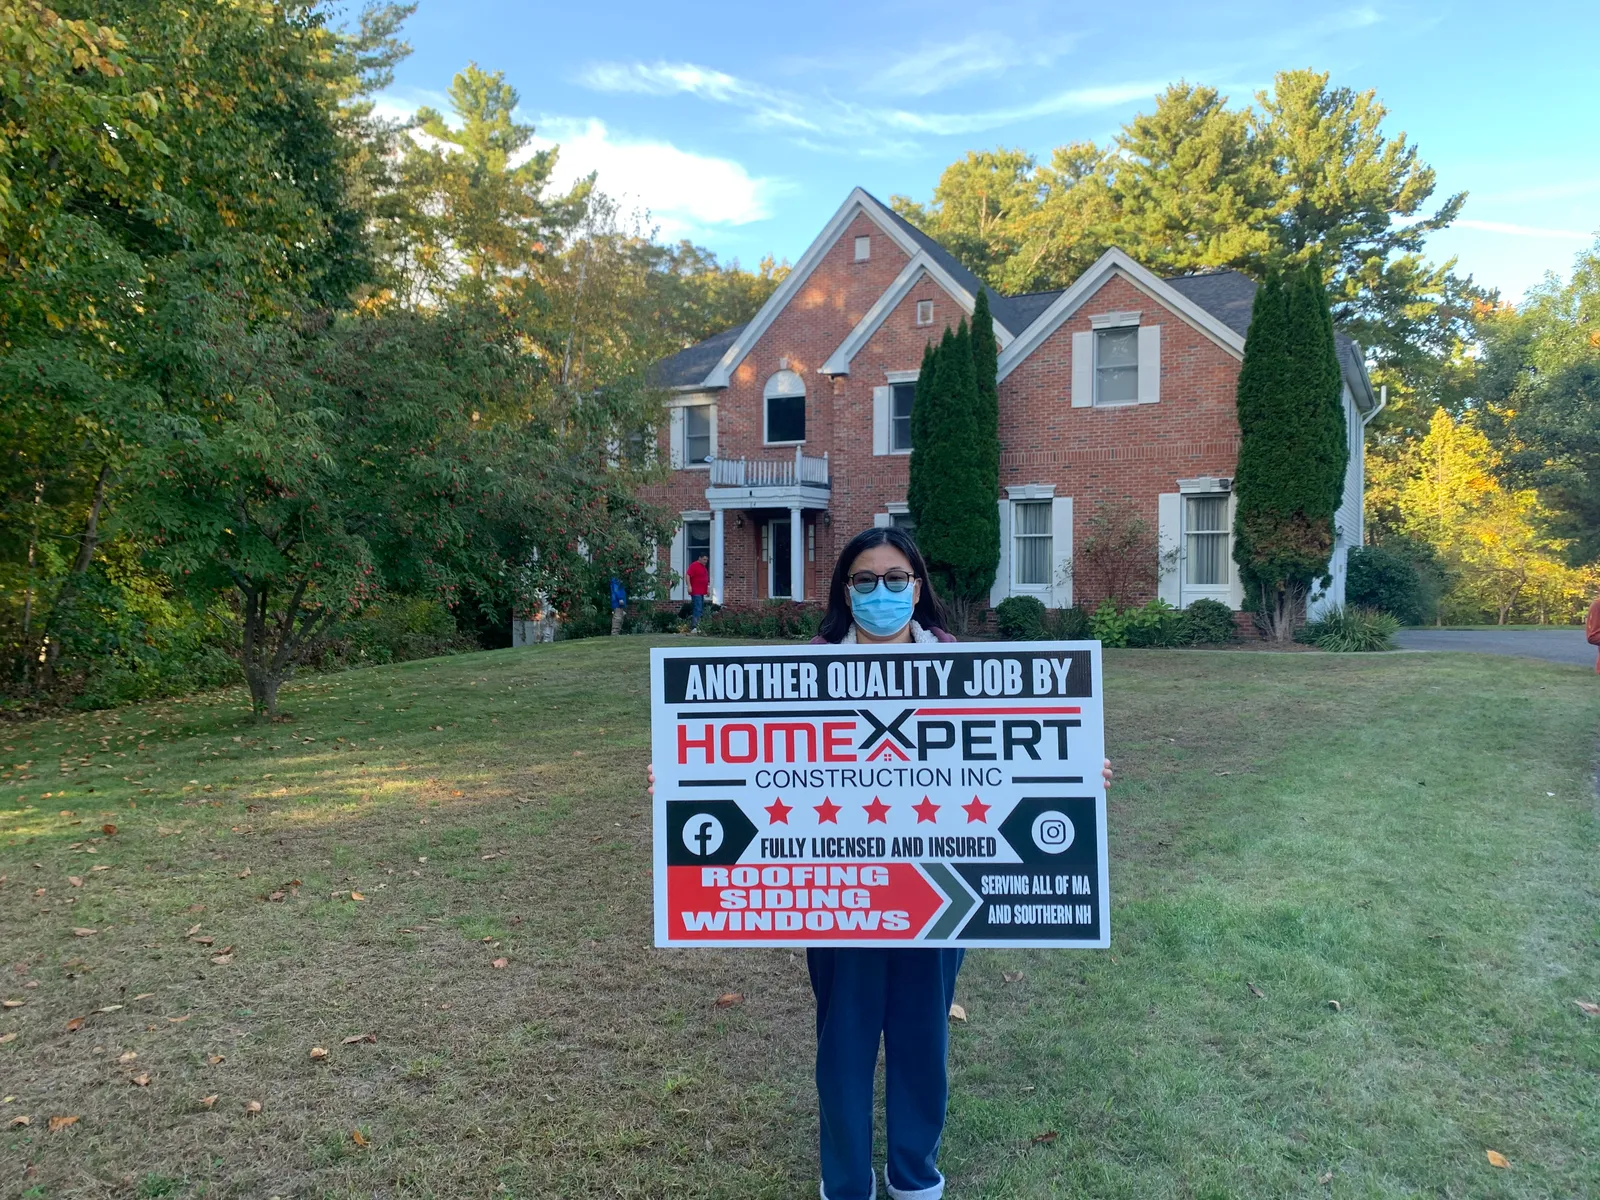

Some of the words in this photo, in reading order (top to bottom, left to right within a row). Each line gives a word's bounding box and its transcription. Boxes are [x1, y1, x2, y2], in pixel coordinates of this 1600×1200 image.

[685, 663, 818, 701] ANOTHER
[827, 660, 954, 698] QUALITY
[963, 658, 1024, 696] JOB
[1032, 657, 1073, 695] BY
[677, 709, 1081, 764] HOMEXPERT
[755, 768, 953, 788] CONSTRUCTION
[961, 767, 1003, 787] INC
[760, 837, 806, 859] FULLY
[811, 837, 886, 858] LICENSED
[890, 837, 924, 858] AND
[928, 836, 997, 857] INSURED
[701, 865, 889, 888] ROOFING
[981, 875, 1030, 895] SERVING
[1032, 875, 1053, 895] ALL
[1055, 875, 1070, 895] OF
[1072, 875, 1091, 895] MA
[719, 888, 871, 910] SIDING
[681, 910, 911, 932] WINDOWS
[988, 905, 1012, 925] AND
[1014, 904, 1073, 925] SOUTHERN
[1076, 904, 1092, 925] NH
